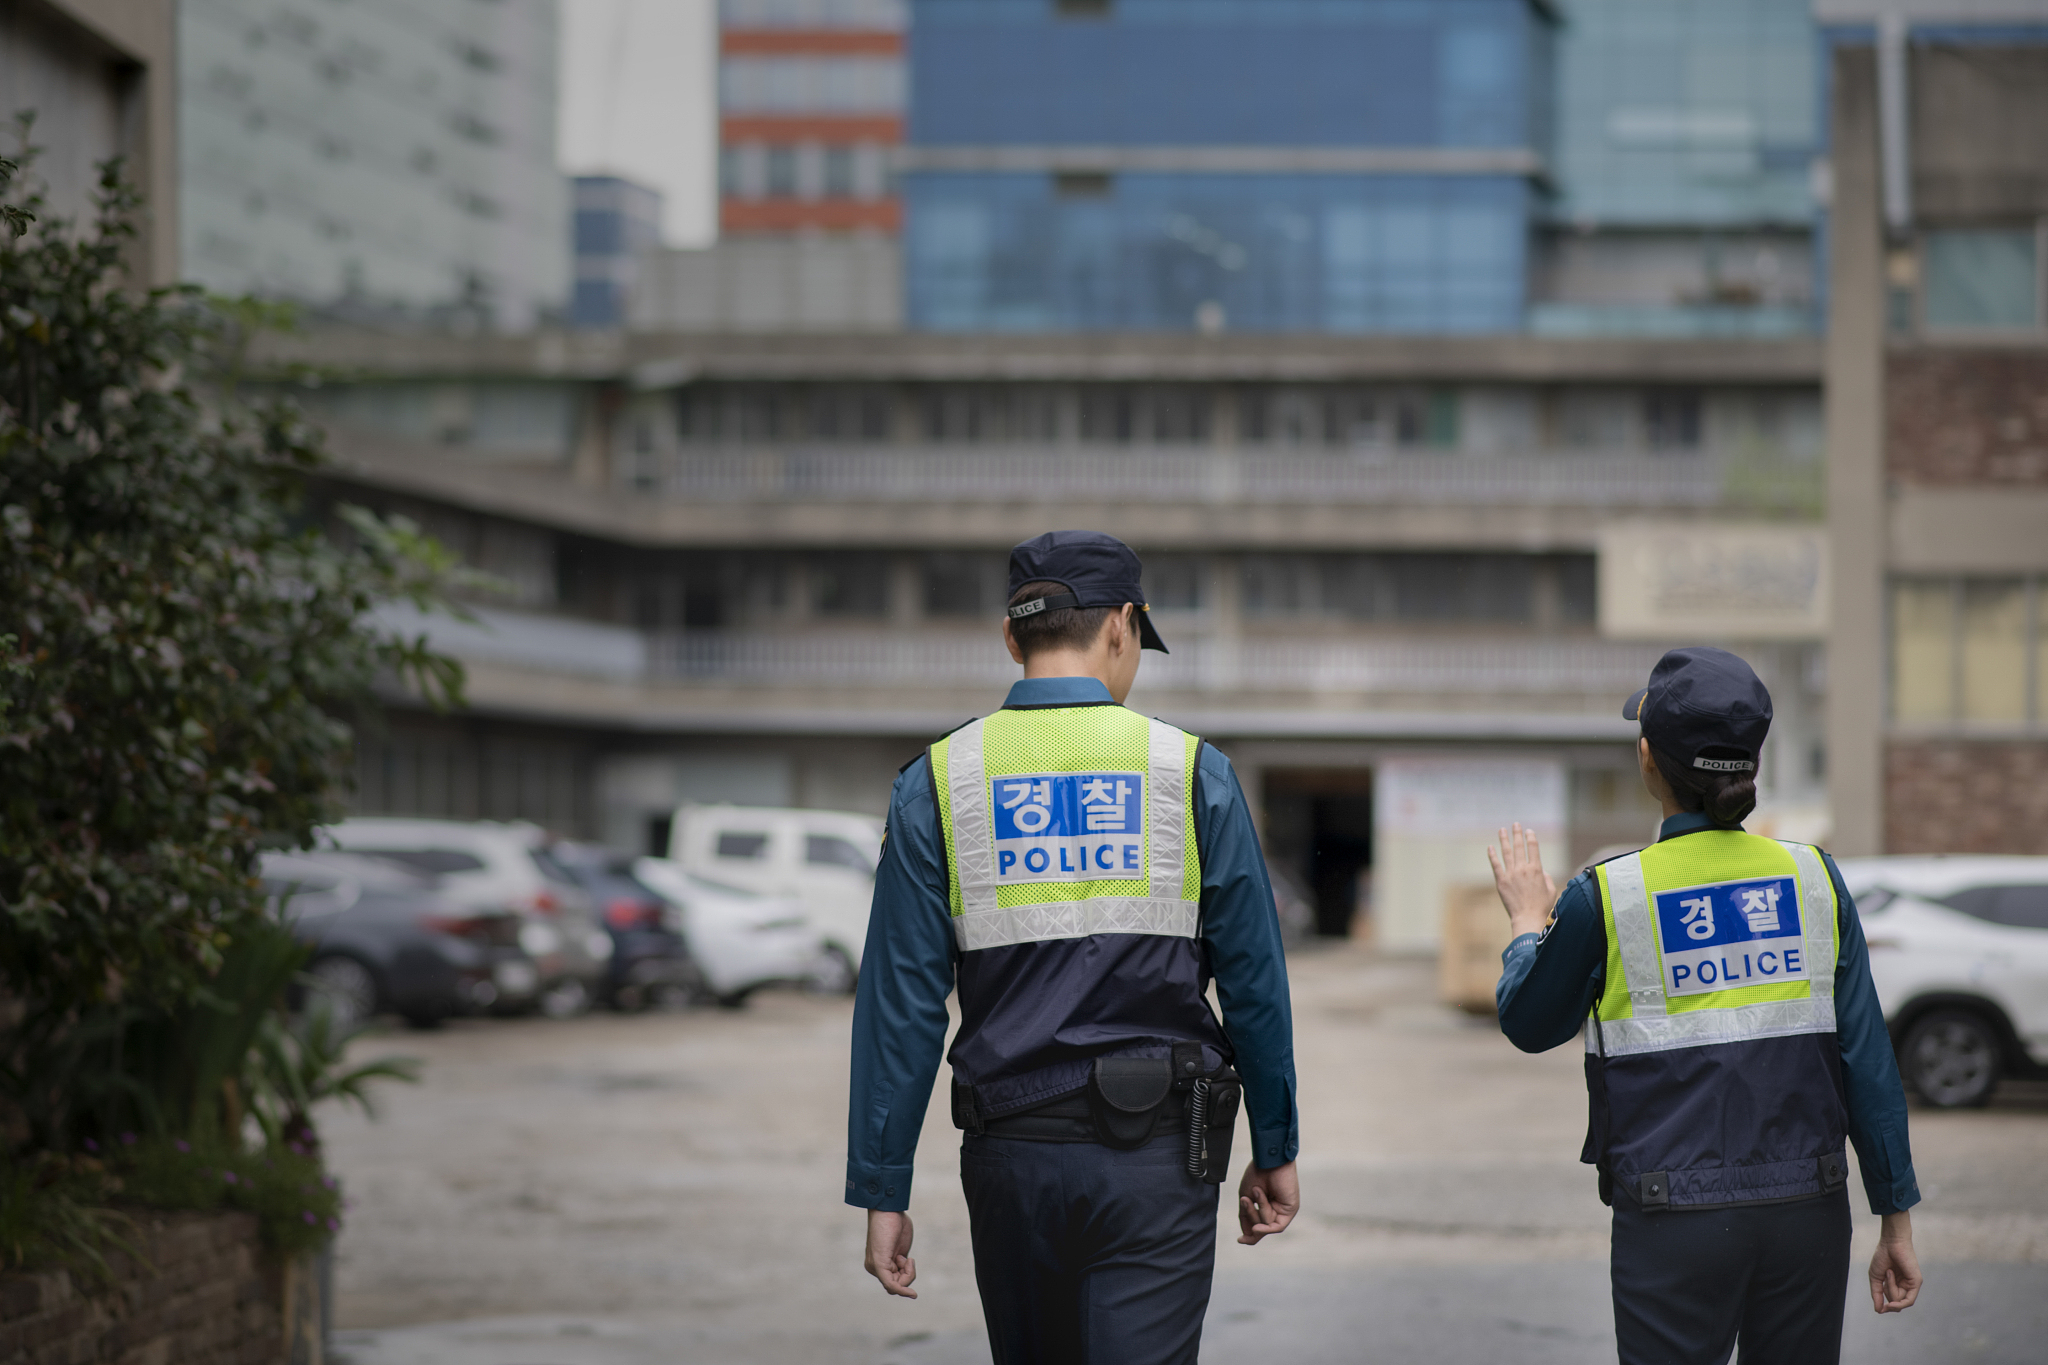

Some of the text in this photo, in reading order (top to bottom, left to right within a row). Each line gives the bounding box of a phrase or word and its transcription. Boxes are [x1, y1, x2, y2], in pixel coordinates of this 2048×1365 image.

[1009, 601, 1042, 617] OLICE
[1702, 760, 1751, 770] POLICE
[998, 844, 1139, 875] POLICE
[1671, 948, 1802, 988] POLICE
